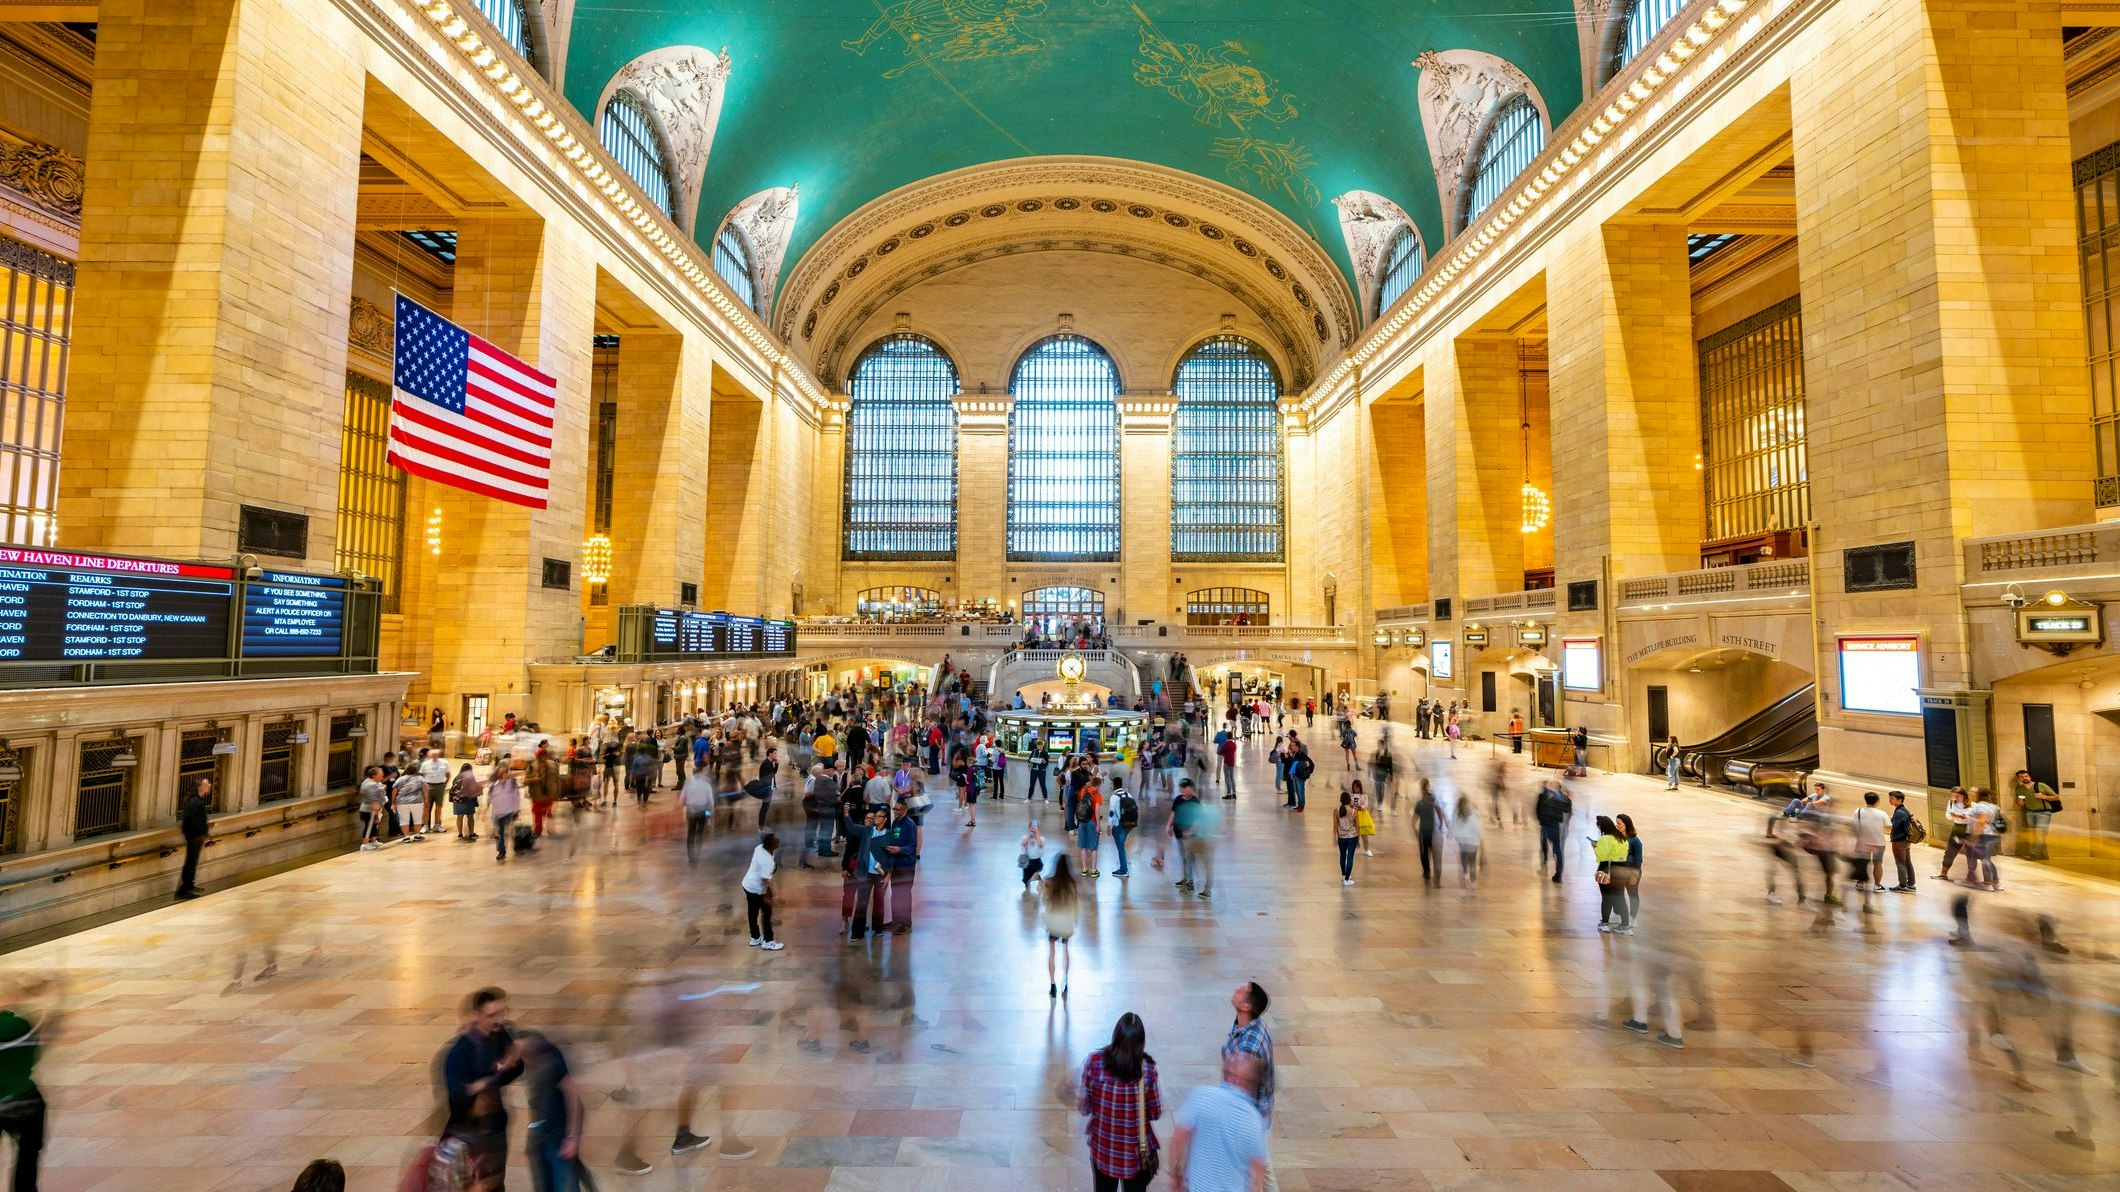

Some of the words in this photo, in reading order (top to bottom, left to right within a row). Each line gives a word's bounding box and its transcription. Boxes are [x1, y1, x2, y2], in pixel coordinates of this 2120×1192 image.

[24, 551, 72, 565] HAVEN
[75, 556, 105, 568] LINE
[107, 558, 179, 574] DEPARTURES
[70, 574, 112, 585] REMARKS
[273, 574, 320, 585] INFORMATION
[0, 583, 28, 591] HAVEN
[69, 586, 111, 596] STAMFORD
[295, 590, 327, 599] SOMETHING,
[0, 596, 24, 604] FORD
[68, 599, 106, 608] FORDHAM
[67, 612, 116, 620] CONNECTION
[129, 614, 163, 622] DANBURY,
[1722, 635, 1742, 646] 45TH
[1744, 638, 1776, 652] STREET
[1626, 654, 1640, 664] THE
[1640, 642, 1665, 658] METLIFE
[1665, 634, 1697, 648] BUILDING
